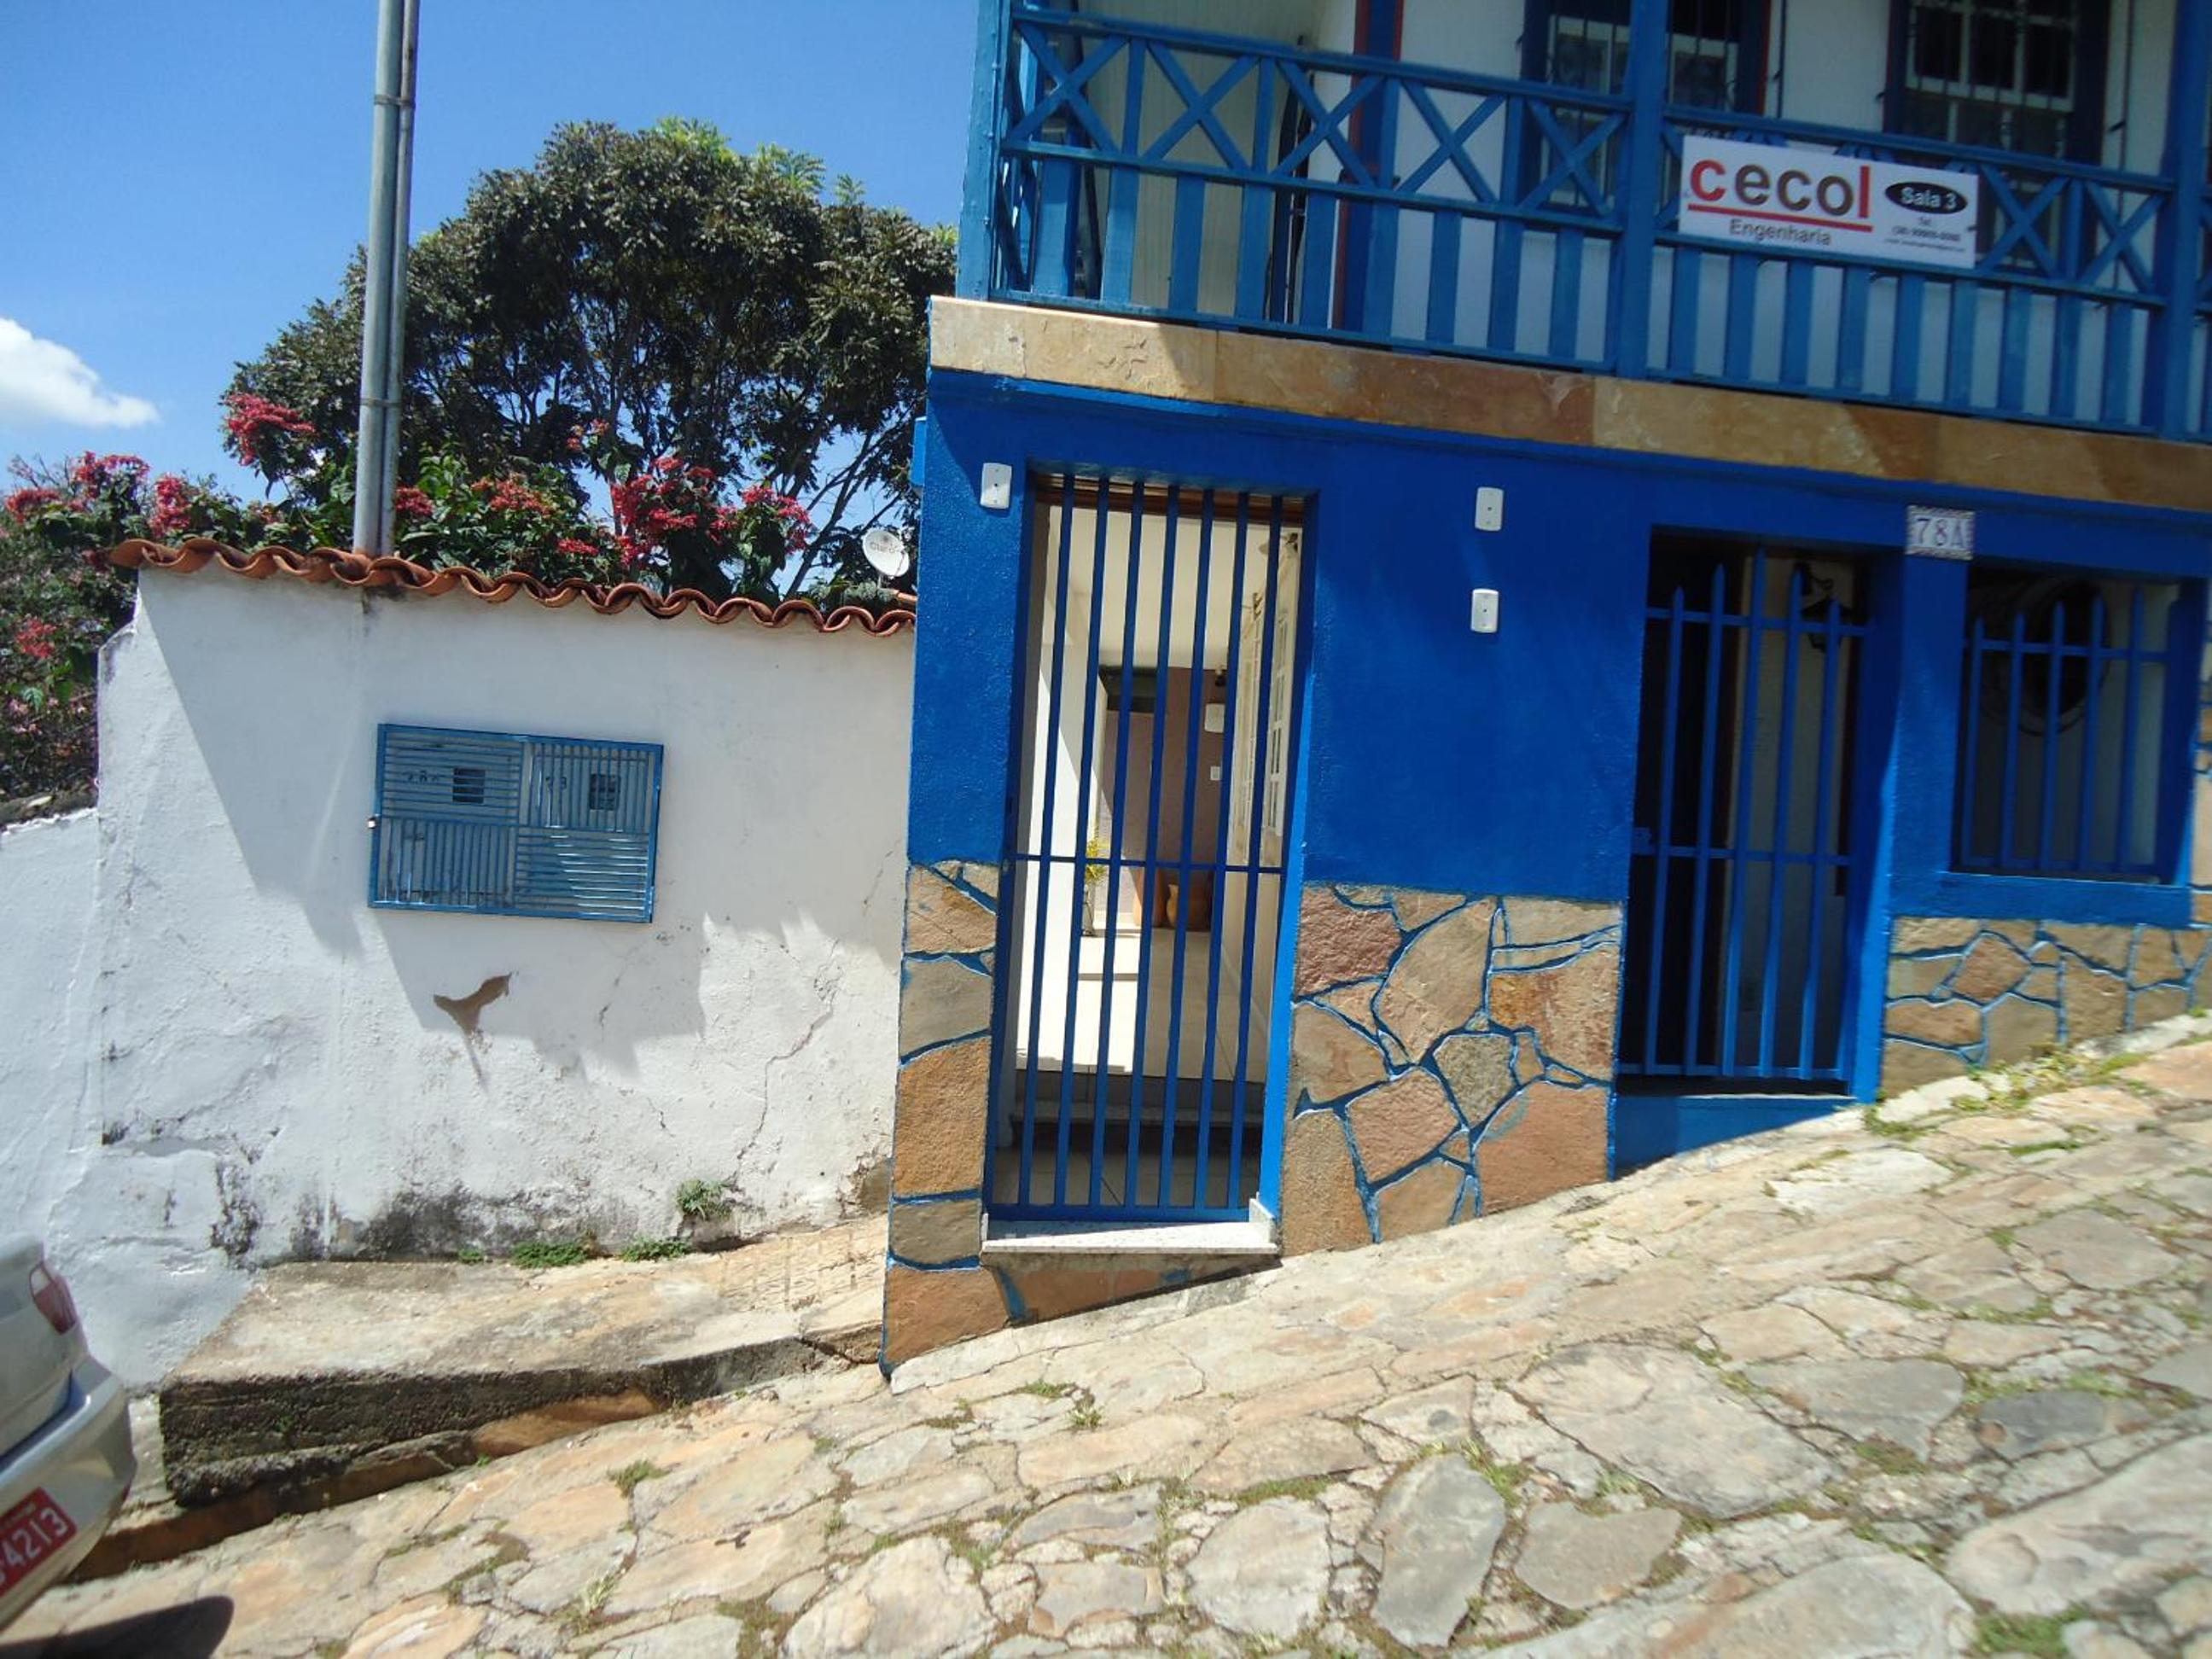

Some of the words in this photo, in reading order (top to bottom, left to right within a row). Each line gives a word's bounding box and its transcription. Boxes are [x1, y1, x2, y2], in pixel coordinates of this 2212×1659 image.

[1690, 160, 1870, 218] cecol
[1901, 186, 1941, 208] Sala
[1946, 193, 1957, 210] 3
[1729, 218, 1831, 245] Engenharia
[0, 1507, 68, 1586] 4213
